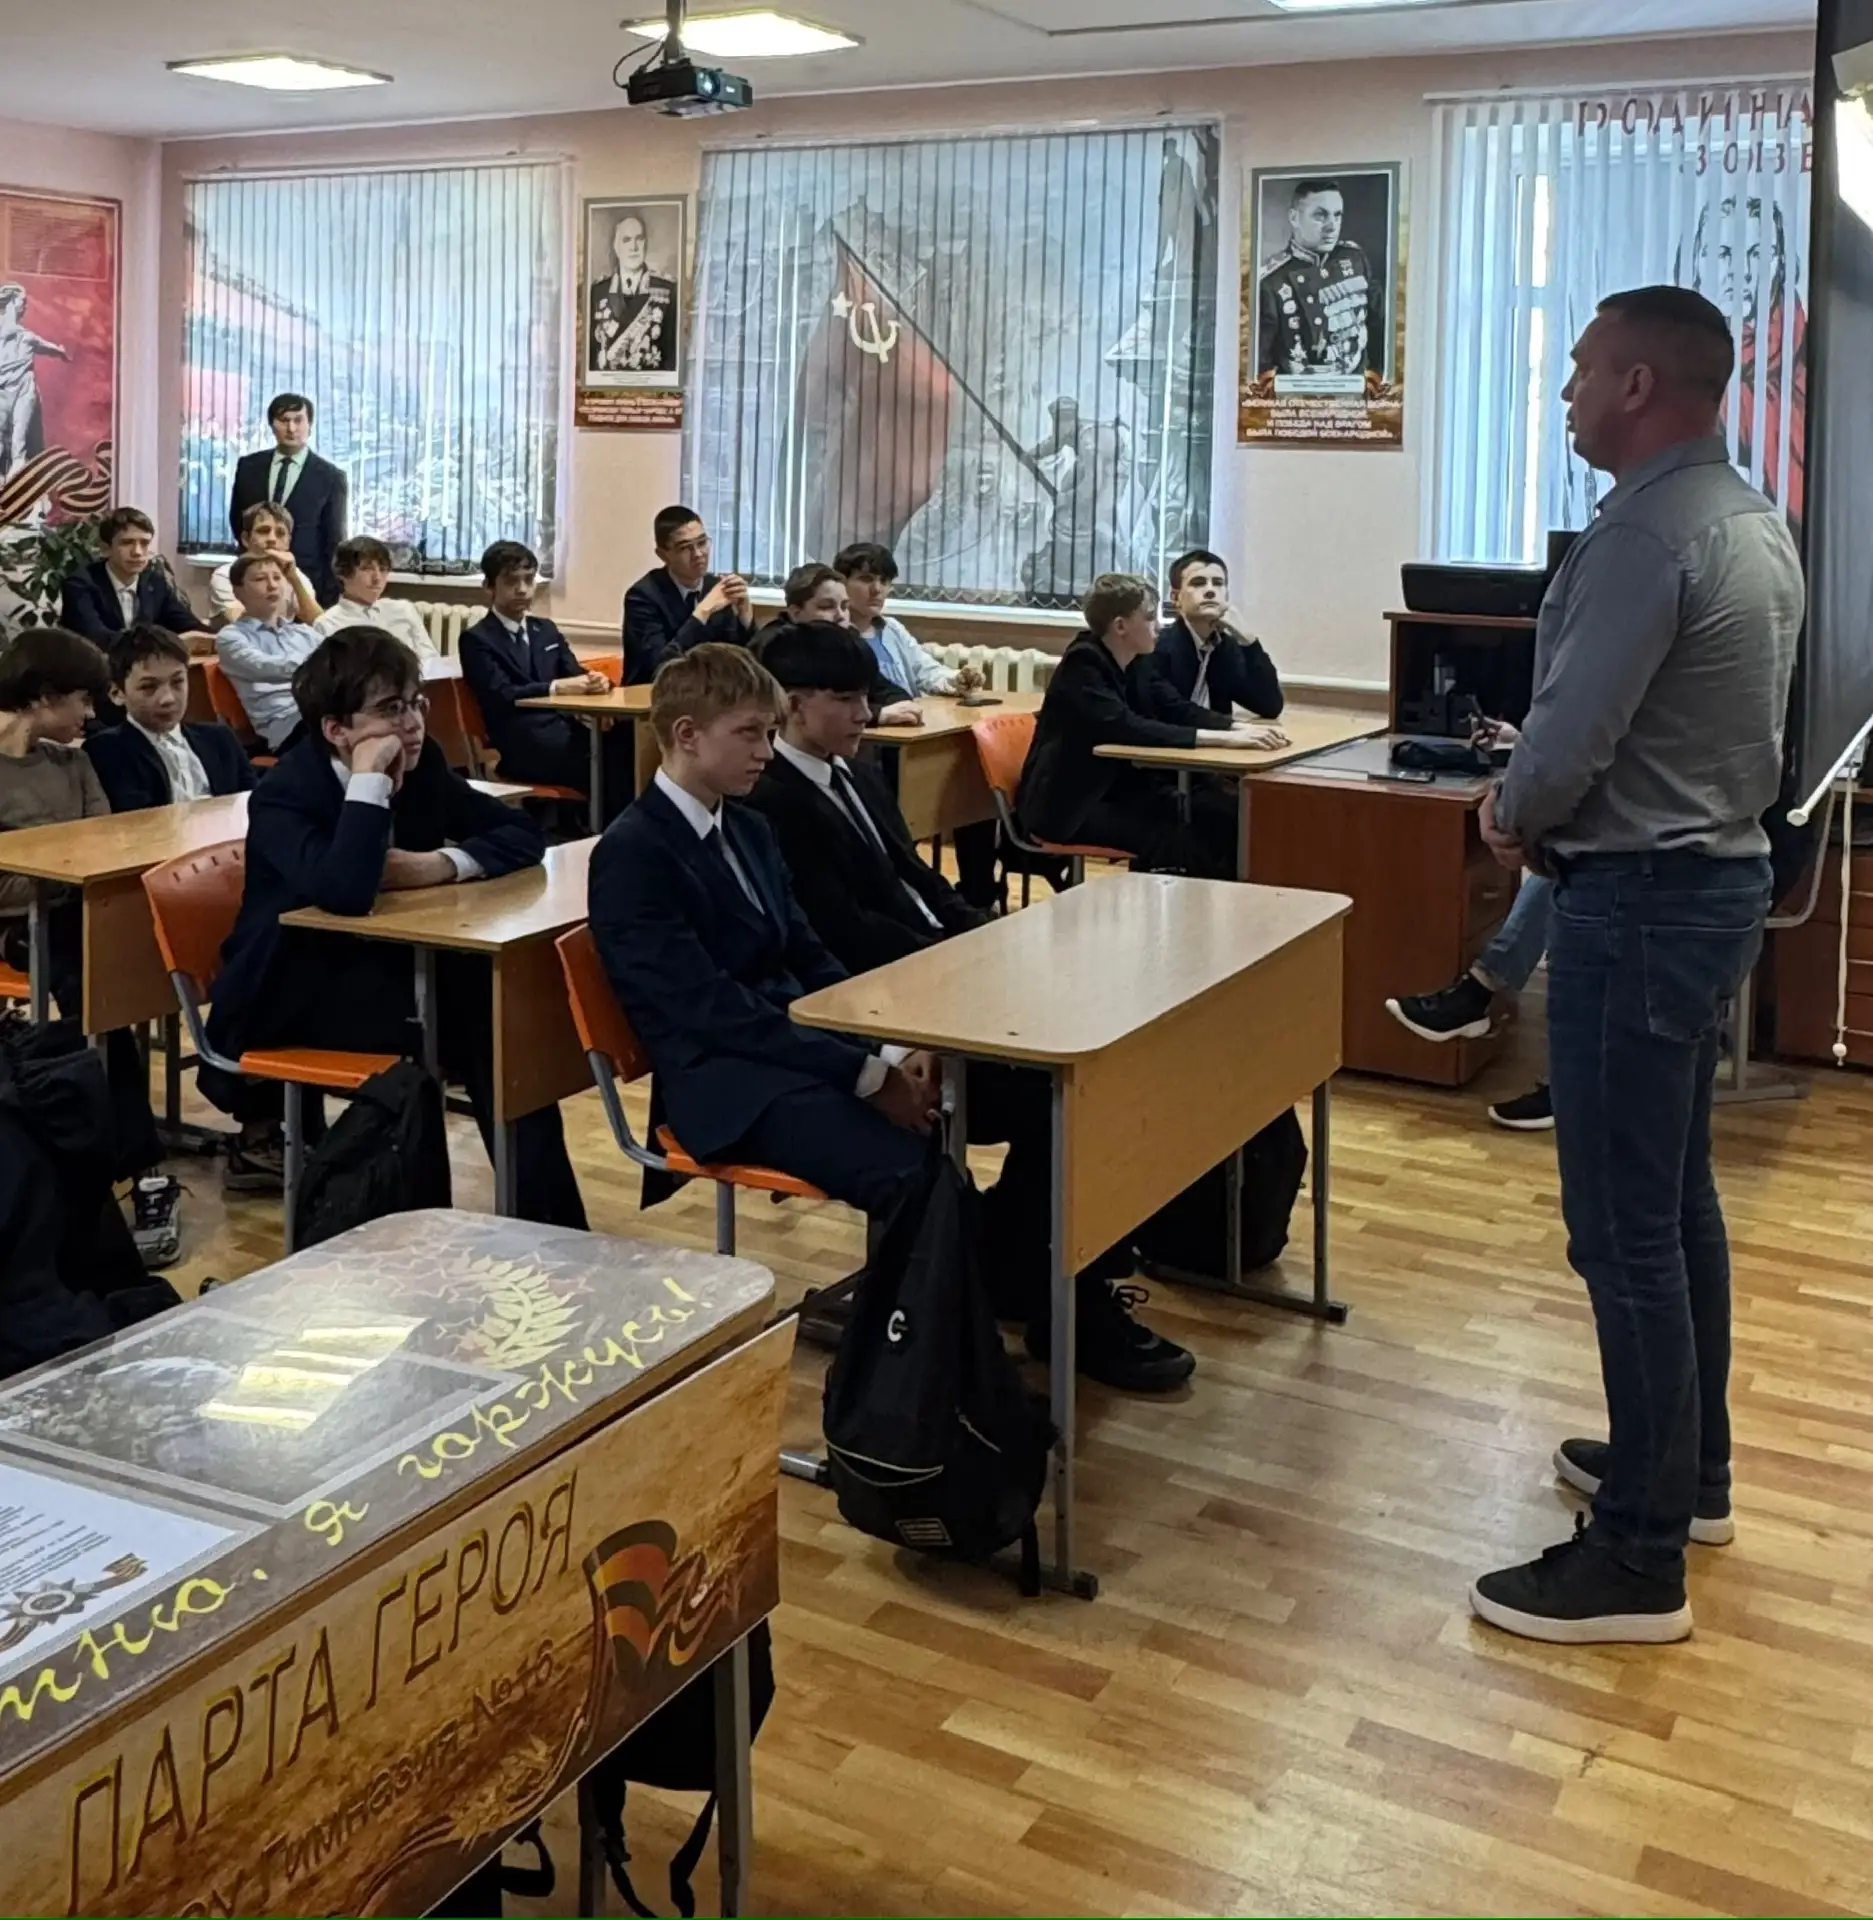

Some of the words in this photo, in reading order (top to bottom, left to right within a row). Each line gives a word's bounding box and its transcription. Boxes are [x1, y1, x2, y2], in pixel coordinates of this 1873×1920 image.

[398, 1277, 713, 1480] горжусь!
[67, 1624, 341, 1917] ПАРТА
[364, 1467, 578, 1712] ГЕРОЯ
